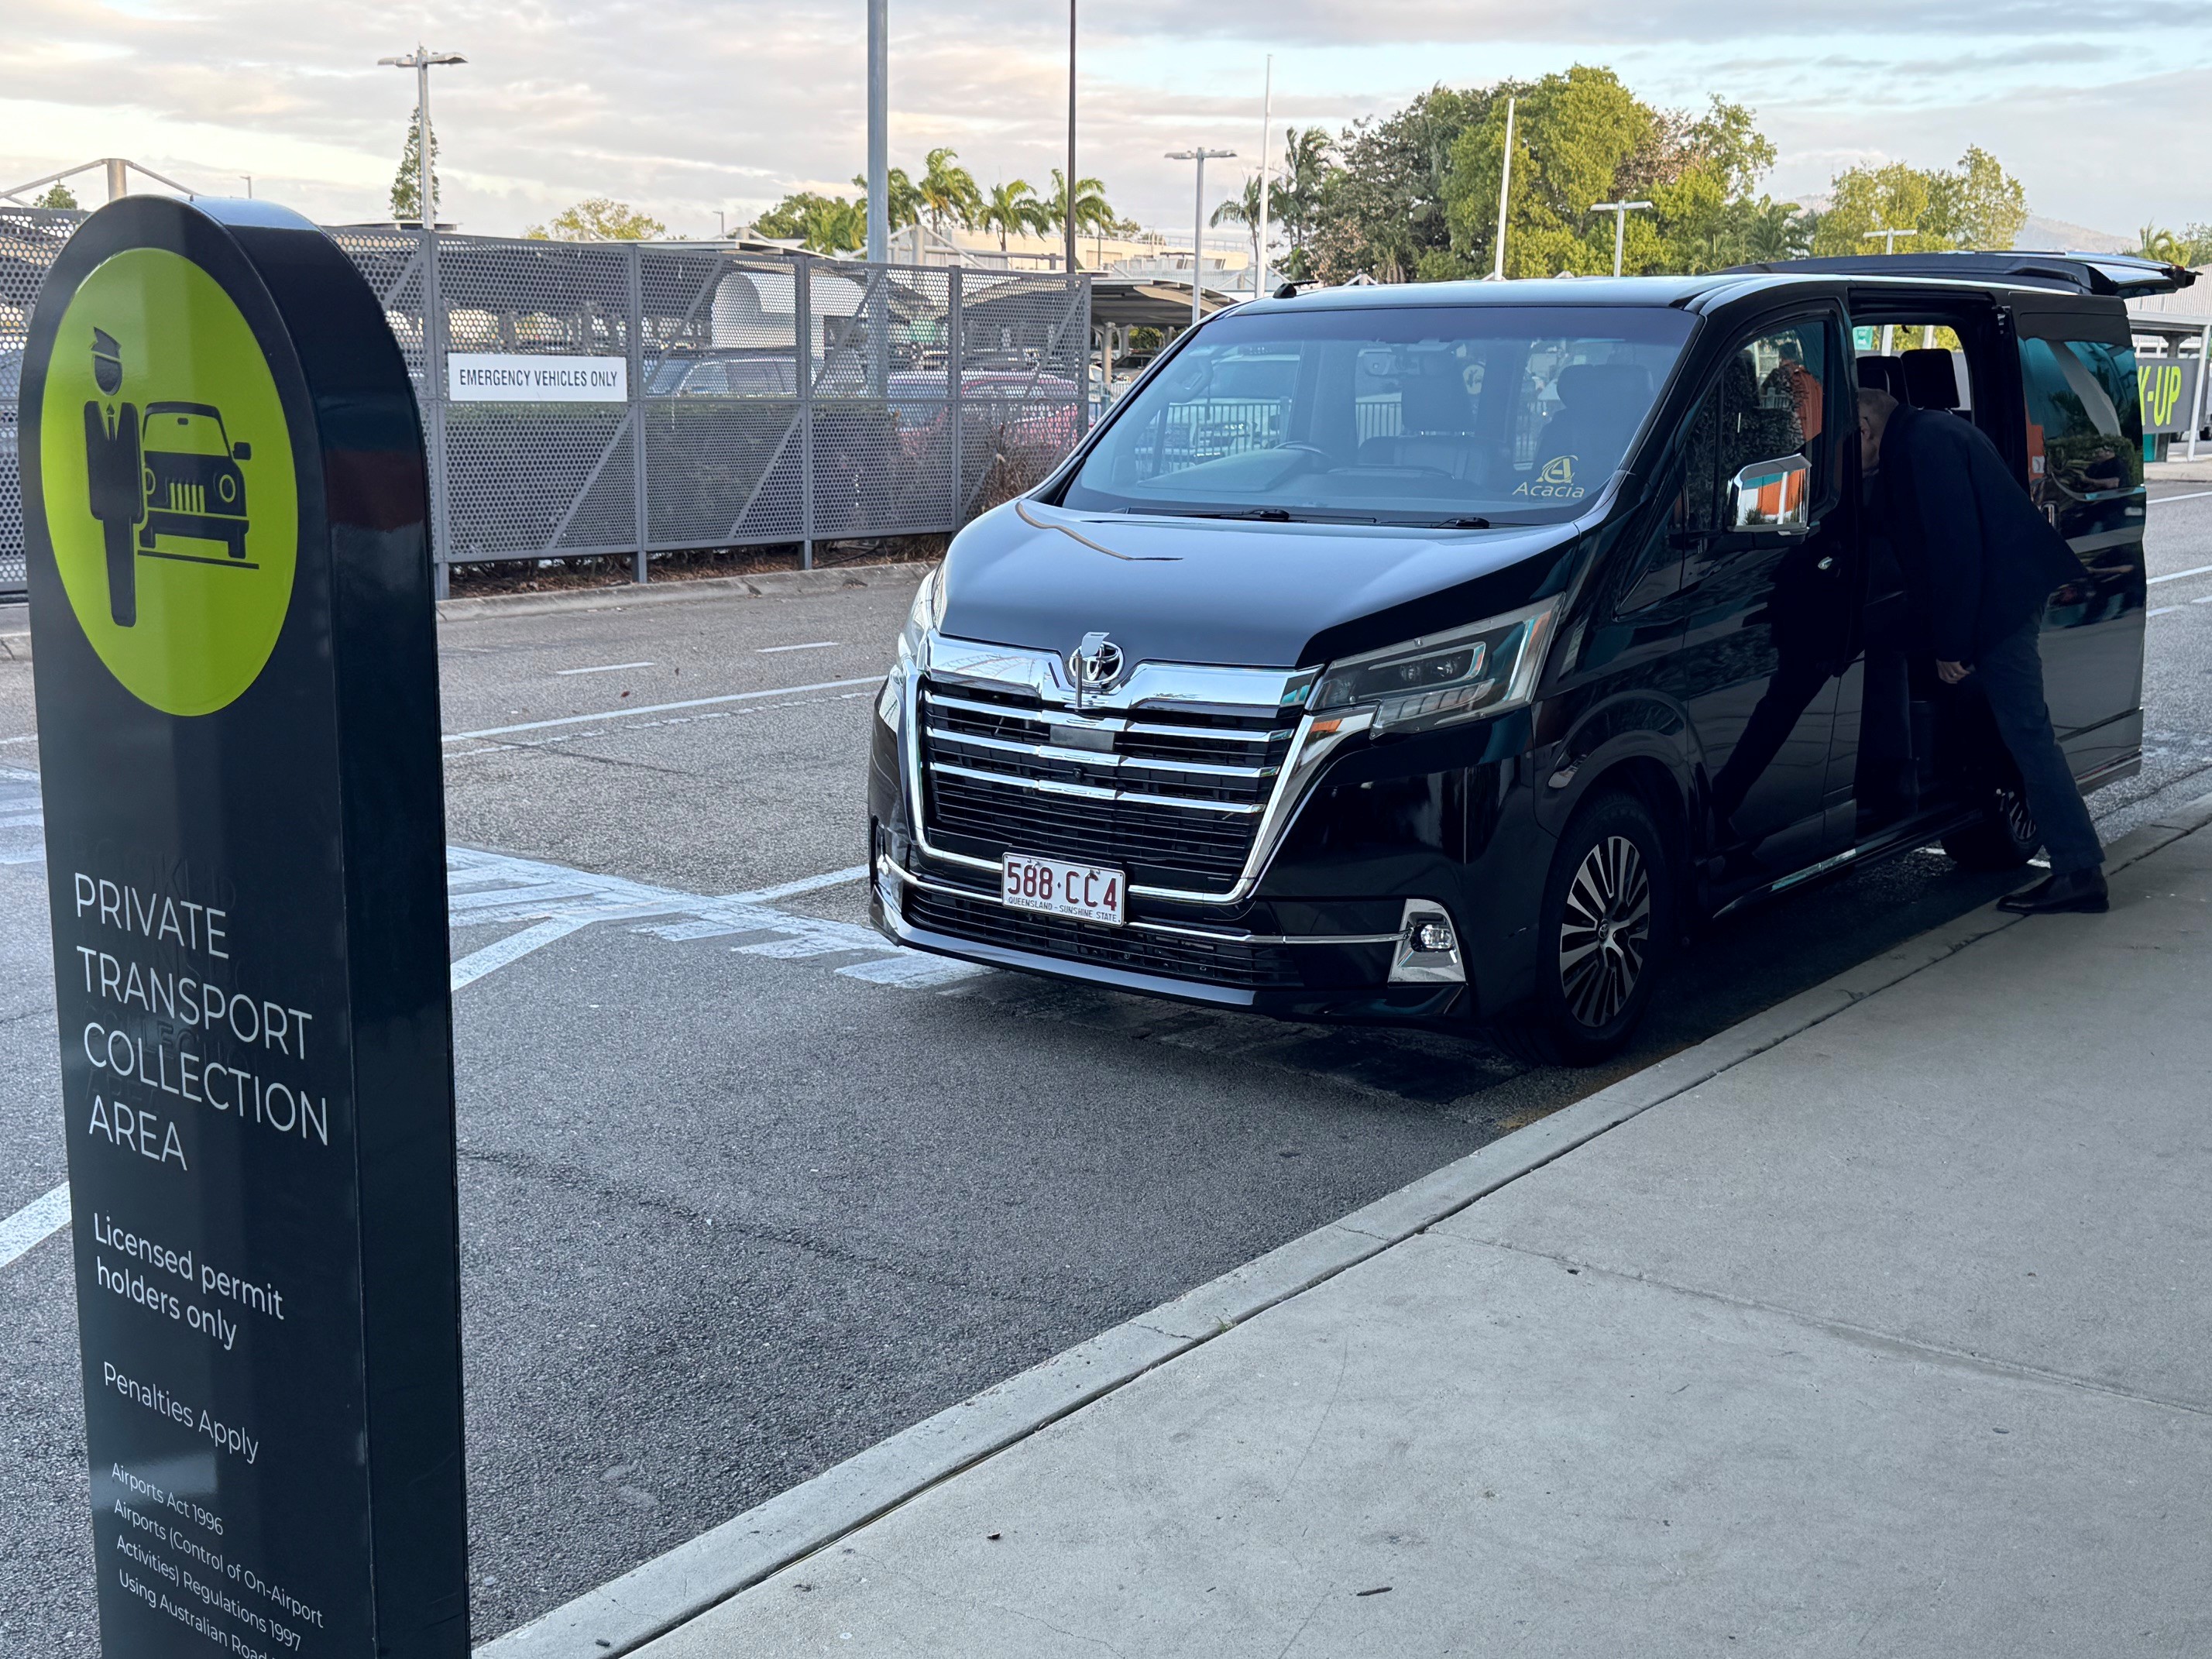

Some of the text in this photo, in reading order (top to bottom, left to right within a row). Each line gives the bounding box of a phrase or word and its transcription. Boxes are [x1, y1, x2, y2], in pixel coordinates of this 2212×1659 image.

[459, 369, 618, 387] EMERGENCY VEHICLES ONLY
[1512, 481, 1585, 498] Acacia
[75, 872, 229, 960] PRIVATE
[1008, 896, 1053, 911] QUEENSLAND
[1059, 904, 1094, 919] SUNSHINE
[1096, 911, 1117, 922] STATE
[77, 946, 313, 1060] TRANSPORT
[84, 1022, 328, 1146] COLLECTION
[88, 1094, 188, 1171] AREA
[94, 1212, 285, 1321] Licensed permit
[97, 1255, 237, 1351] holders only
[104, 1361, 259, 1465] Penalties Apply
[112, 1462, 224, 1536] Airports Act 1996
[114, 1499, 324, 1629] Airports (Control of On-Airport
[116, 1534, 301, 1652] Activities) Regulations 1997
[118, 1568, 157, 1609] Using
[160, 1594, 228, 1648] Australian
